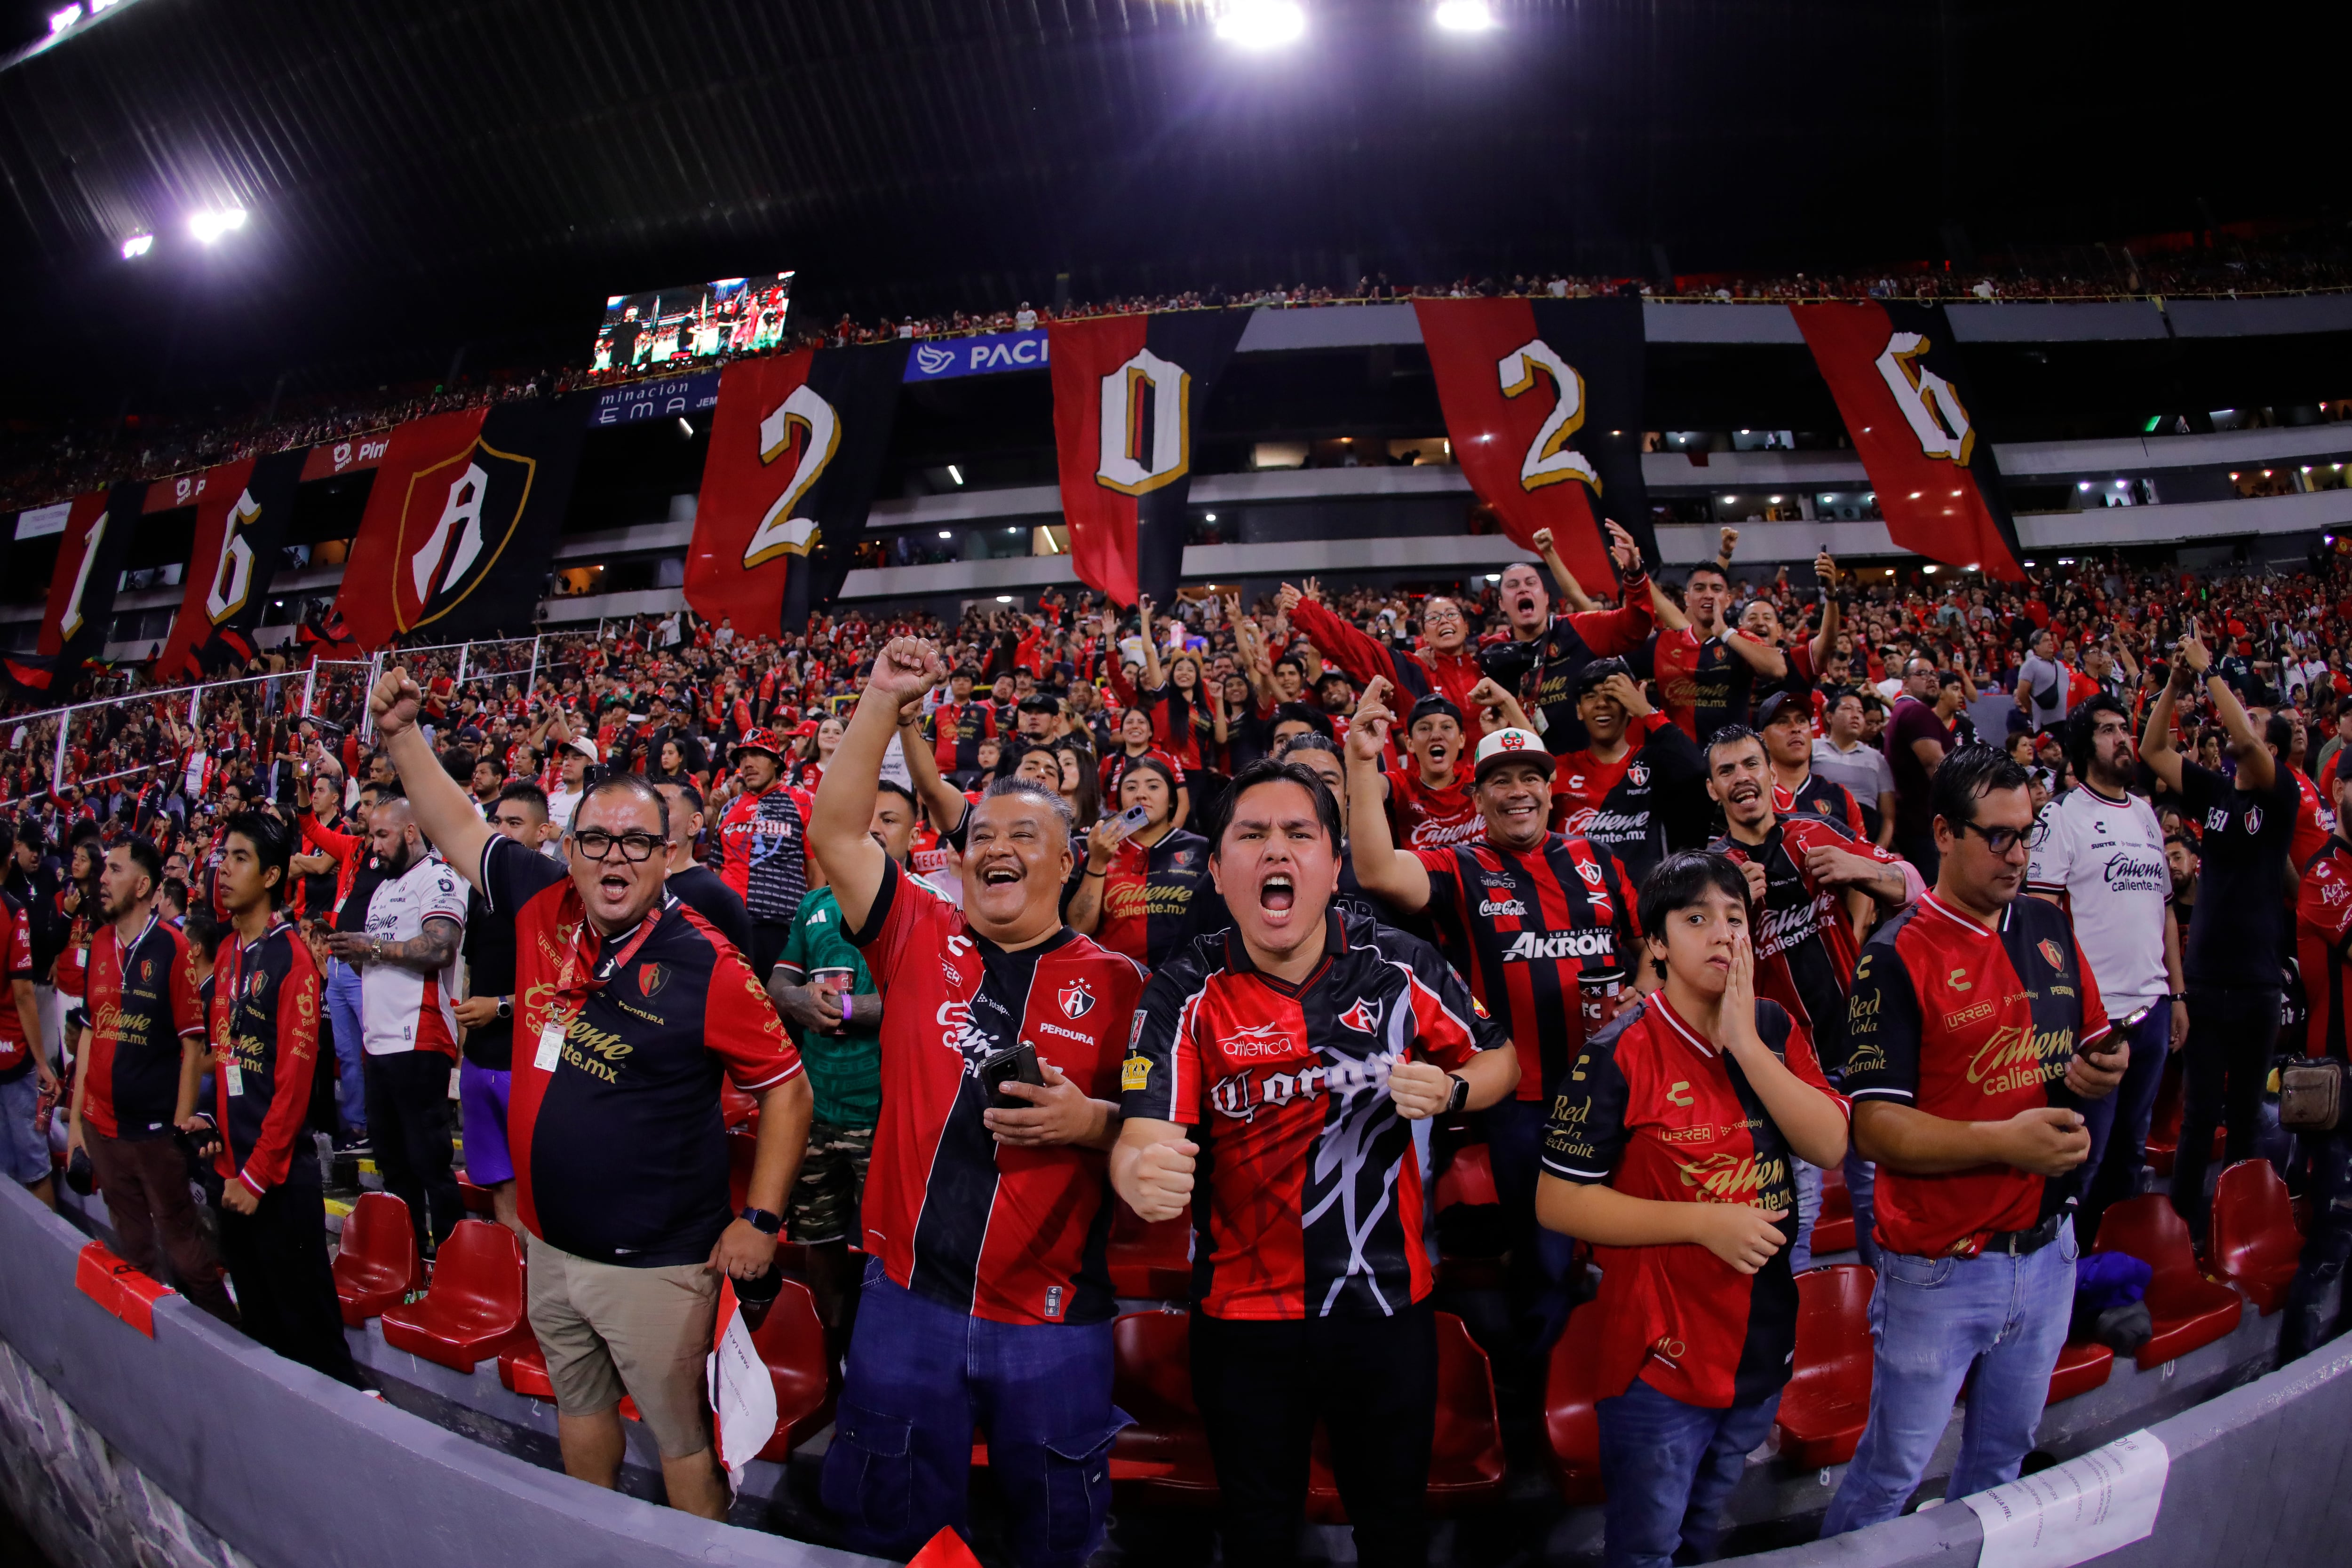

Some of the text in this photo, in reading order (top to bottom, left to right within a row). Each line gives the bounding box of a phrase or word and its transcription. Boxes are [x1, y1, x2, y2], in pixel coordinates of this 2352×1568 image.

[1875, 332, 1976, 467] 6
[1096, 347, 1192, 498] 0
[1498, 339, 1603, 499] 2
[743, 383, 842, 570] 2
[205, 487, 262, 626] 6
[61, 510, 109, 643] 1
[2091, 841, 2117, 850] SURTEX
[2102, 851, 2163, 883] Caliente
[1104, 881, 1193, 913] Caliente
[1479, 899, 1528, 917] Coca-Cola
[1502, 932, 1613, 961] AKRON
[95, 1001, 151, 1031] Caliente
[1848, 988, 1881, 1023] Red
[1947, 1003, 1993, 1028] URREA
[95, 1028, 149, 1045] caliente.mx
[1040, 1022, 1094, 1046] PERDURA
[1851, 1017, 1878, 1035] Cola
[1223, 1037, 1292, 1056] atletica
[1550, 1094, 1592, 1125] Red
[1662, 1127, 1711, 1142] URREA
[1732, 1119, 1763, 1130] Totalplay
[732, 1338, 739, 1349] LA
[738, 1350, 749, 1370] PARA
[1986, 1489, 1999, 1500] CON
